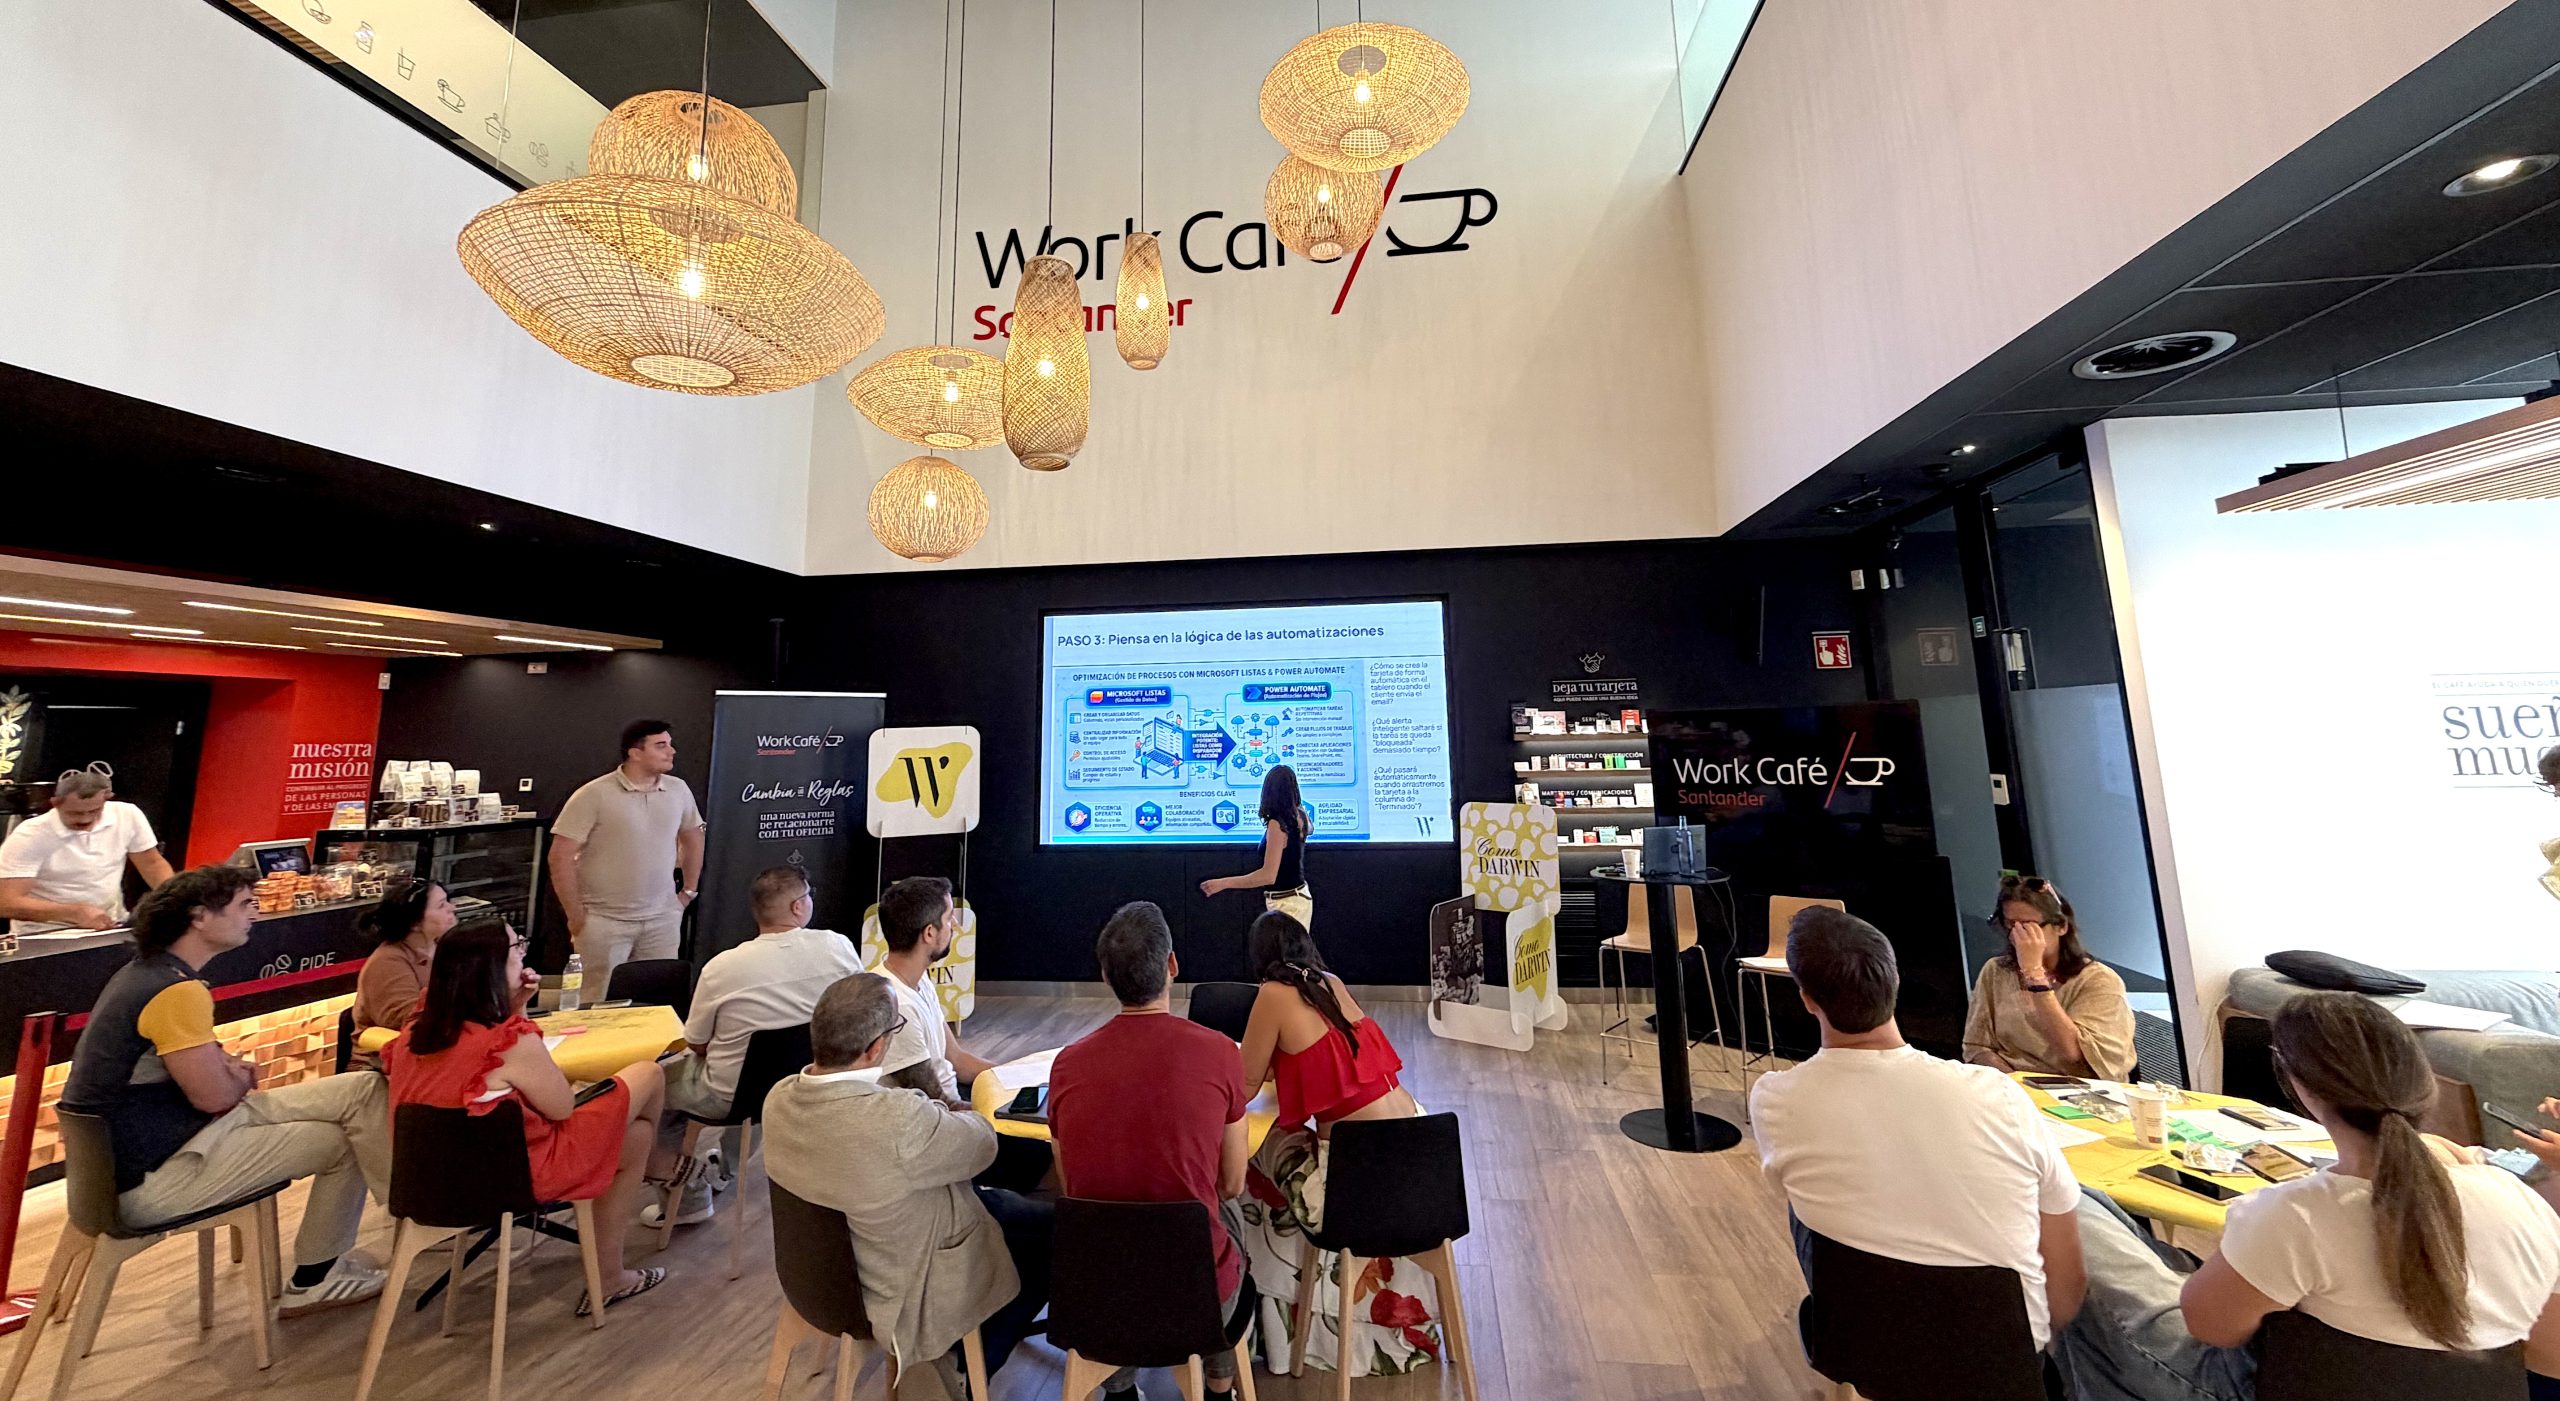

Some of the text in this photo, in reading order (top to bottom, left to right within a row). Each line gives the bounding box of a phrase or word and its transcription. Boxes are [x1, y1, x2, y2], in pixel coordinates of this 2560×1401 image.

[1058, 626, 1384, 646] PASO 3: Piensa en la lógica de las automatizaciones
[1073, 672, 1125, 681] OPTIMIZACIÓN
[1138, 672, 1177, 680] PROCESOS
[1179, 671, 1195, 679] CON
[1196, 670, 1239, 678] MICROSOFT
[291, 743, 372, 758] nuestra
[757, 735, 820, 747] Work Café
[288, 758, 370, 779] misión
[1673, 757, 1828, 785] Work Café
[285, 791, 367, 802] DE LAS PERSONAS
[742, 782, 796, 802] Cambia
[807, 780, 854, 806] Reglas
[1678, 790, 1767, 806] Santander
[780, 812, 806, 820] nueva
[1477, 837, 1520, 857] Como
[1479, 856, 1540, 878] DARWIN
[1514, 934, 1539, 961] Como
[300, 952, 336, 971] PIDE
[1514, 948, 1550, 985] DARWIN
